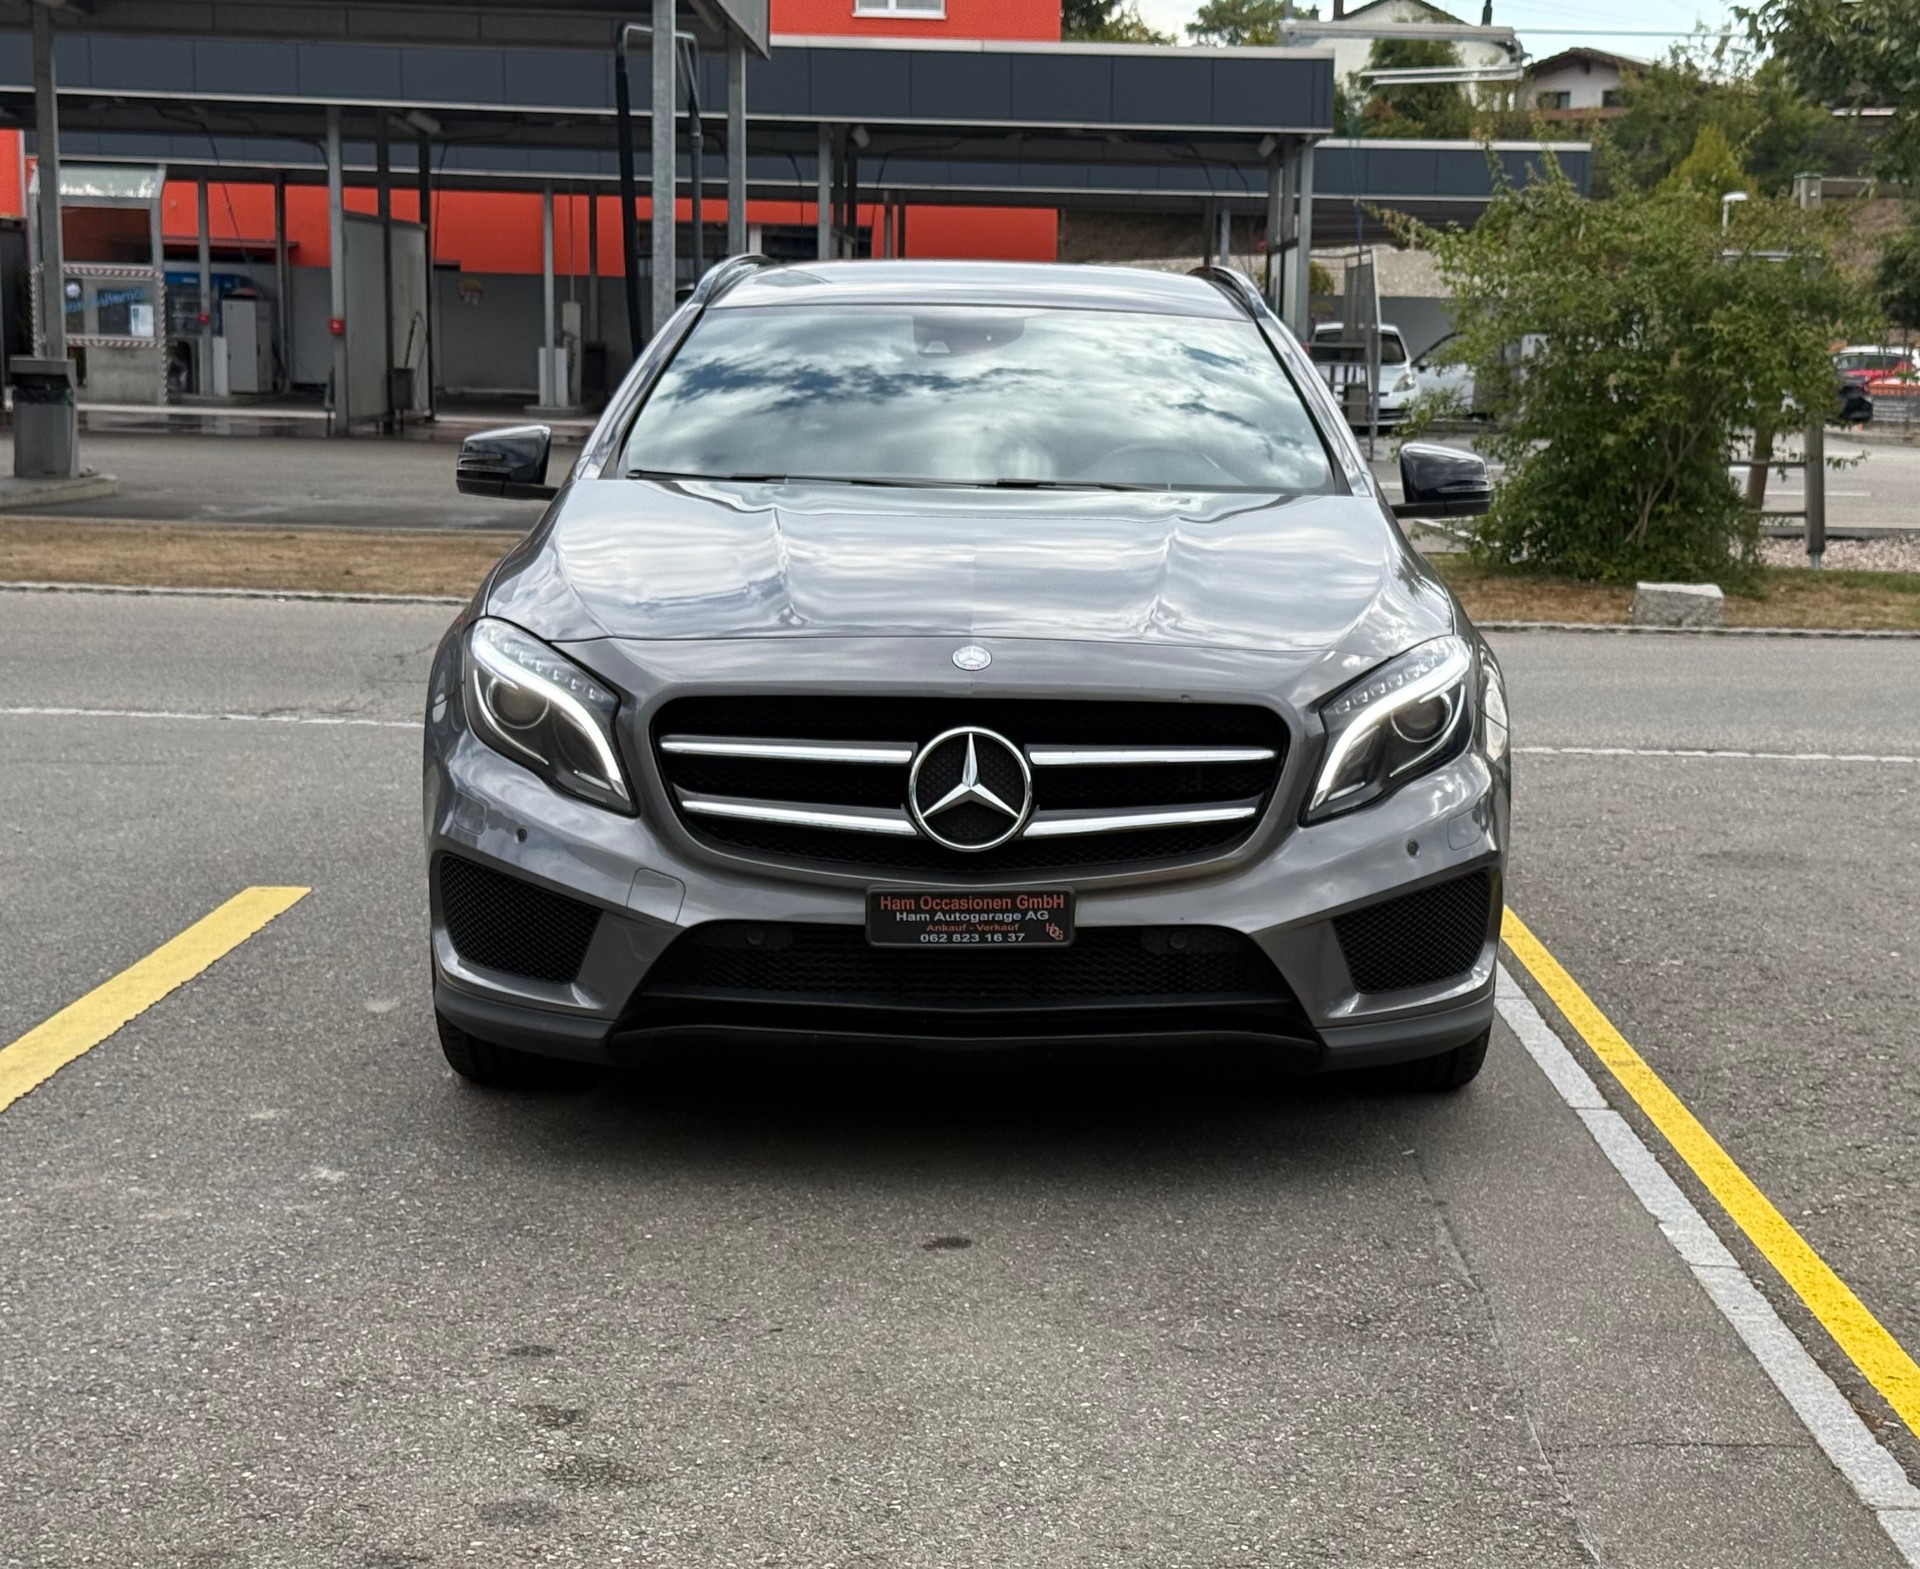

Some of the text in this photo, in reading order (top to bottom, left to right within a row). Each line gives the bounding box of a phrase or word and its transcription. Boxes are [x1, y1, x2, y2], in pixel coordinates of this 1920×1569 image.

[880, 894, 1064, 911] Ham Occasionen GmbH
[896, 910, 1049, 924] Ham Autogarage AG
[926, 924, 967, 932] Ankauf
[976, 923, 1019, 932] Verkauf
[920, 933, 1025, 943] 062 823 16 37
